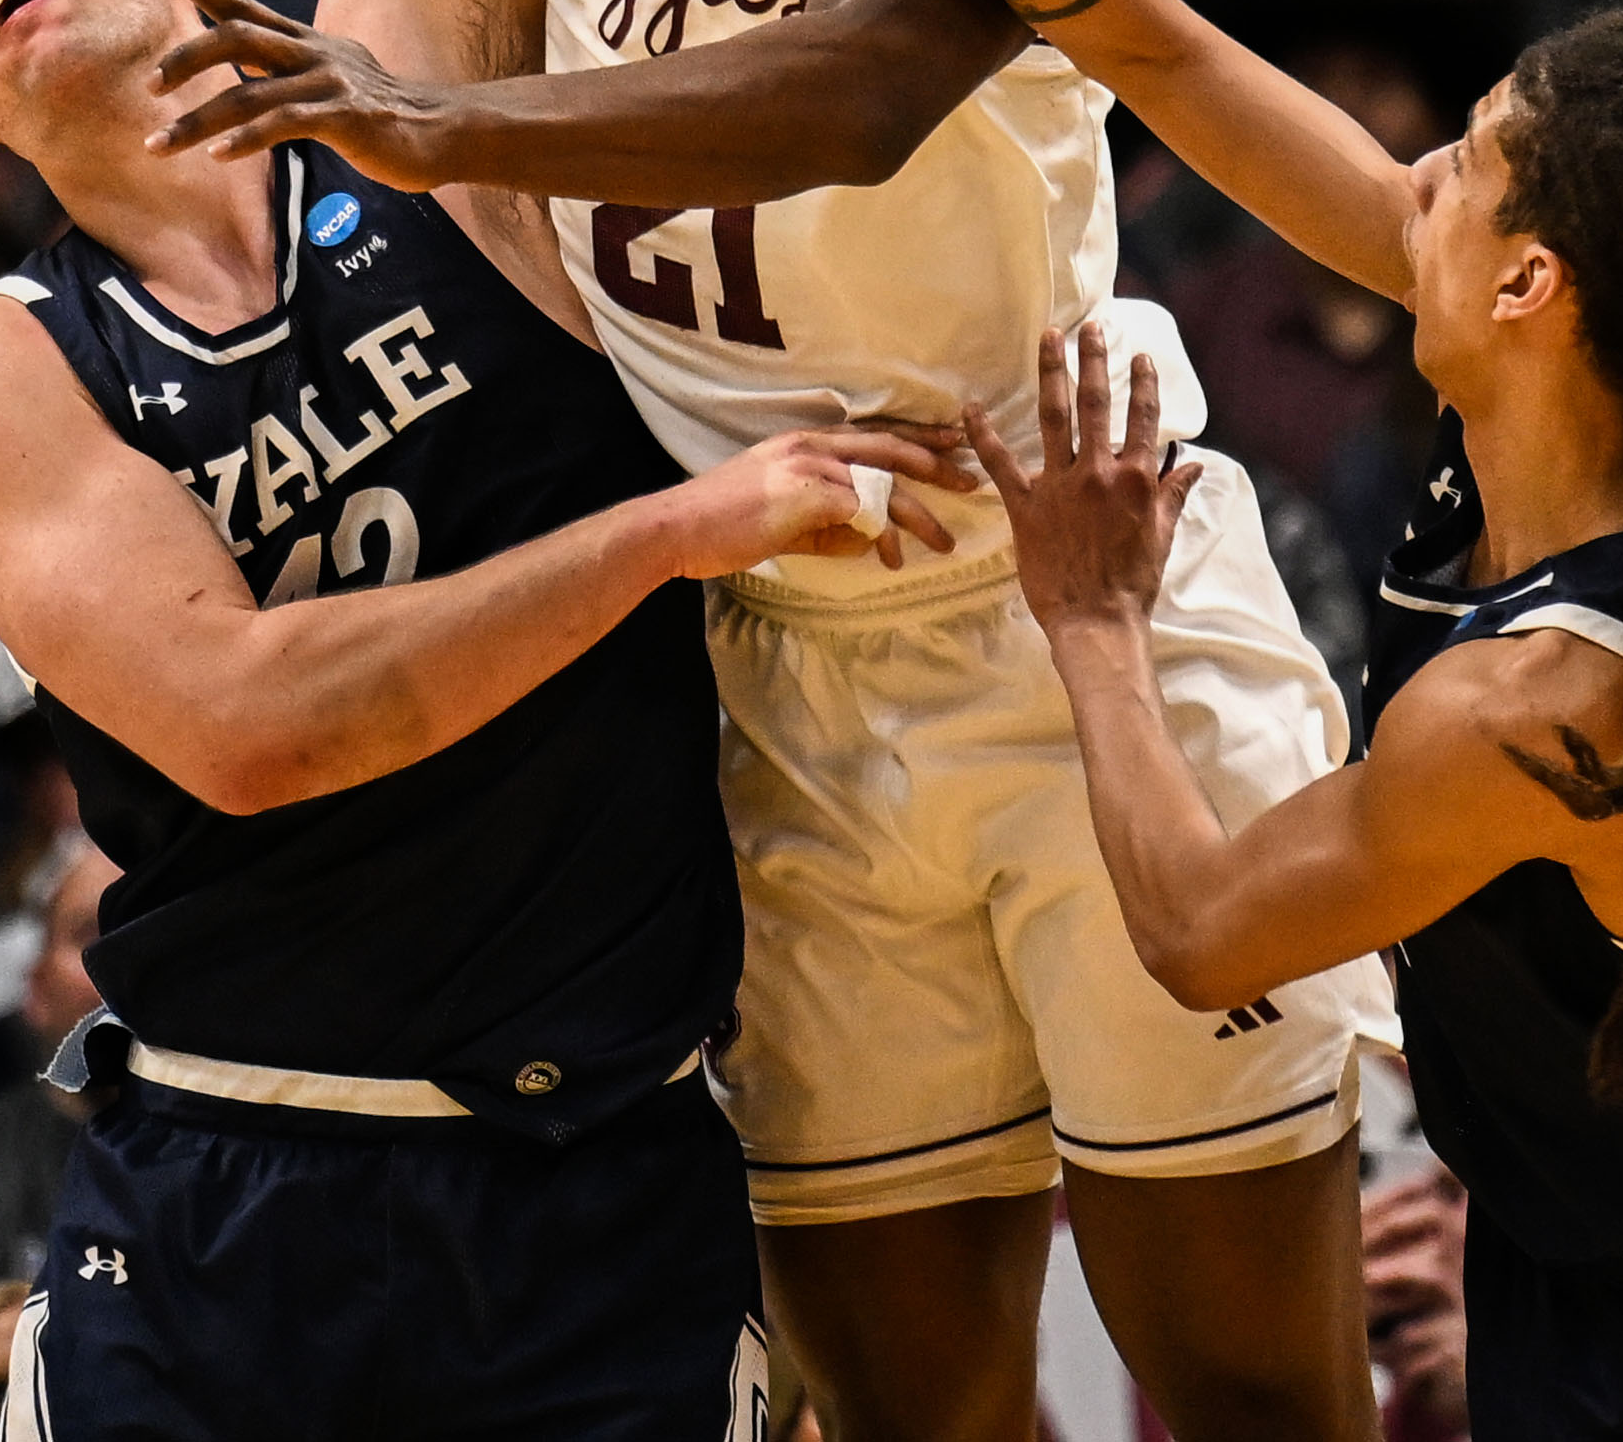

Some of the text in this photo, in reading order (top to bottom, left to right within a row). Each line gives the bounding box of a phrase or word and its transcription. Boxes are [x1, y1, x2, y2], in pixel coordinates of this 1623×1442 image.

[316, 201, 358, 243] NCAA
[336, 245, 373, 278] Ivy
[172, 305, 474, 559] YALE
